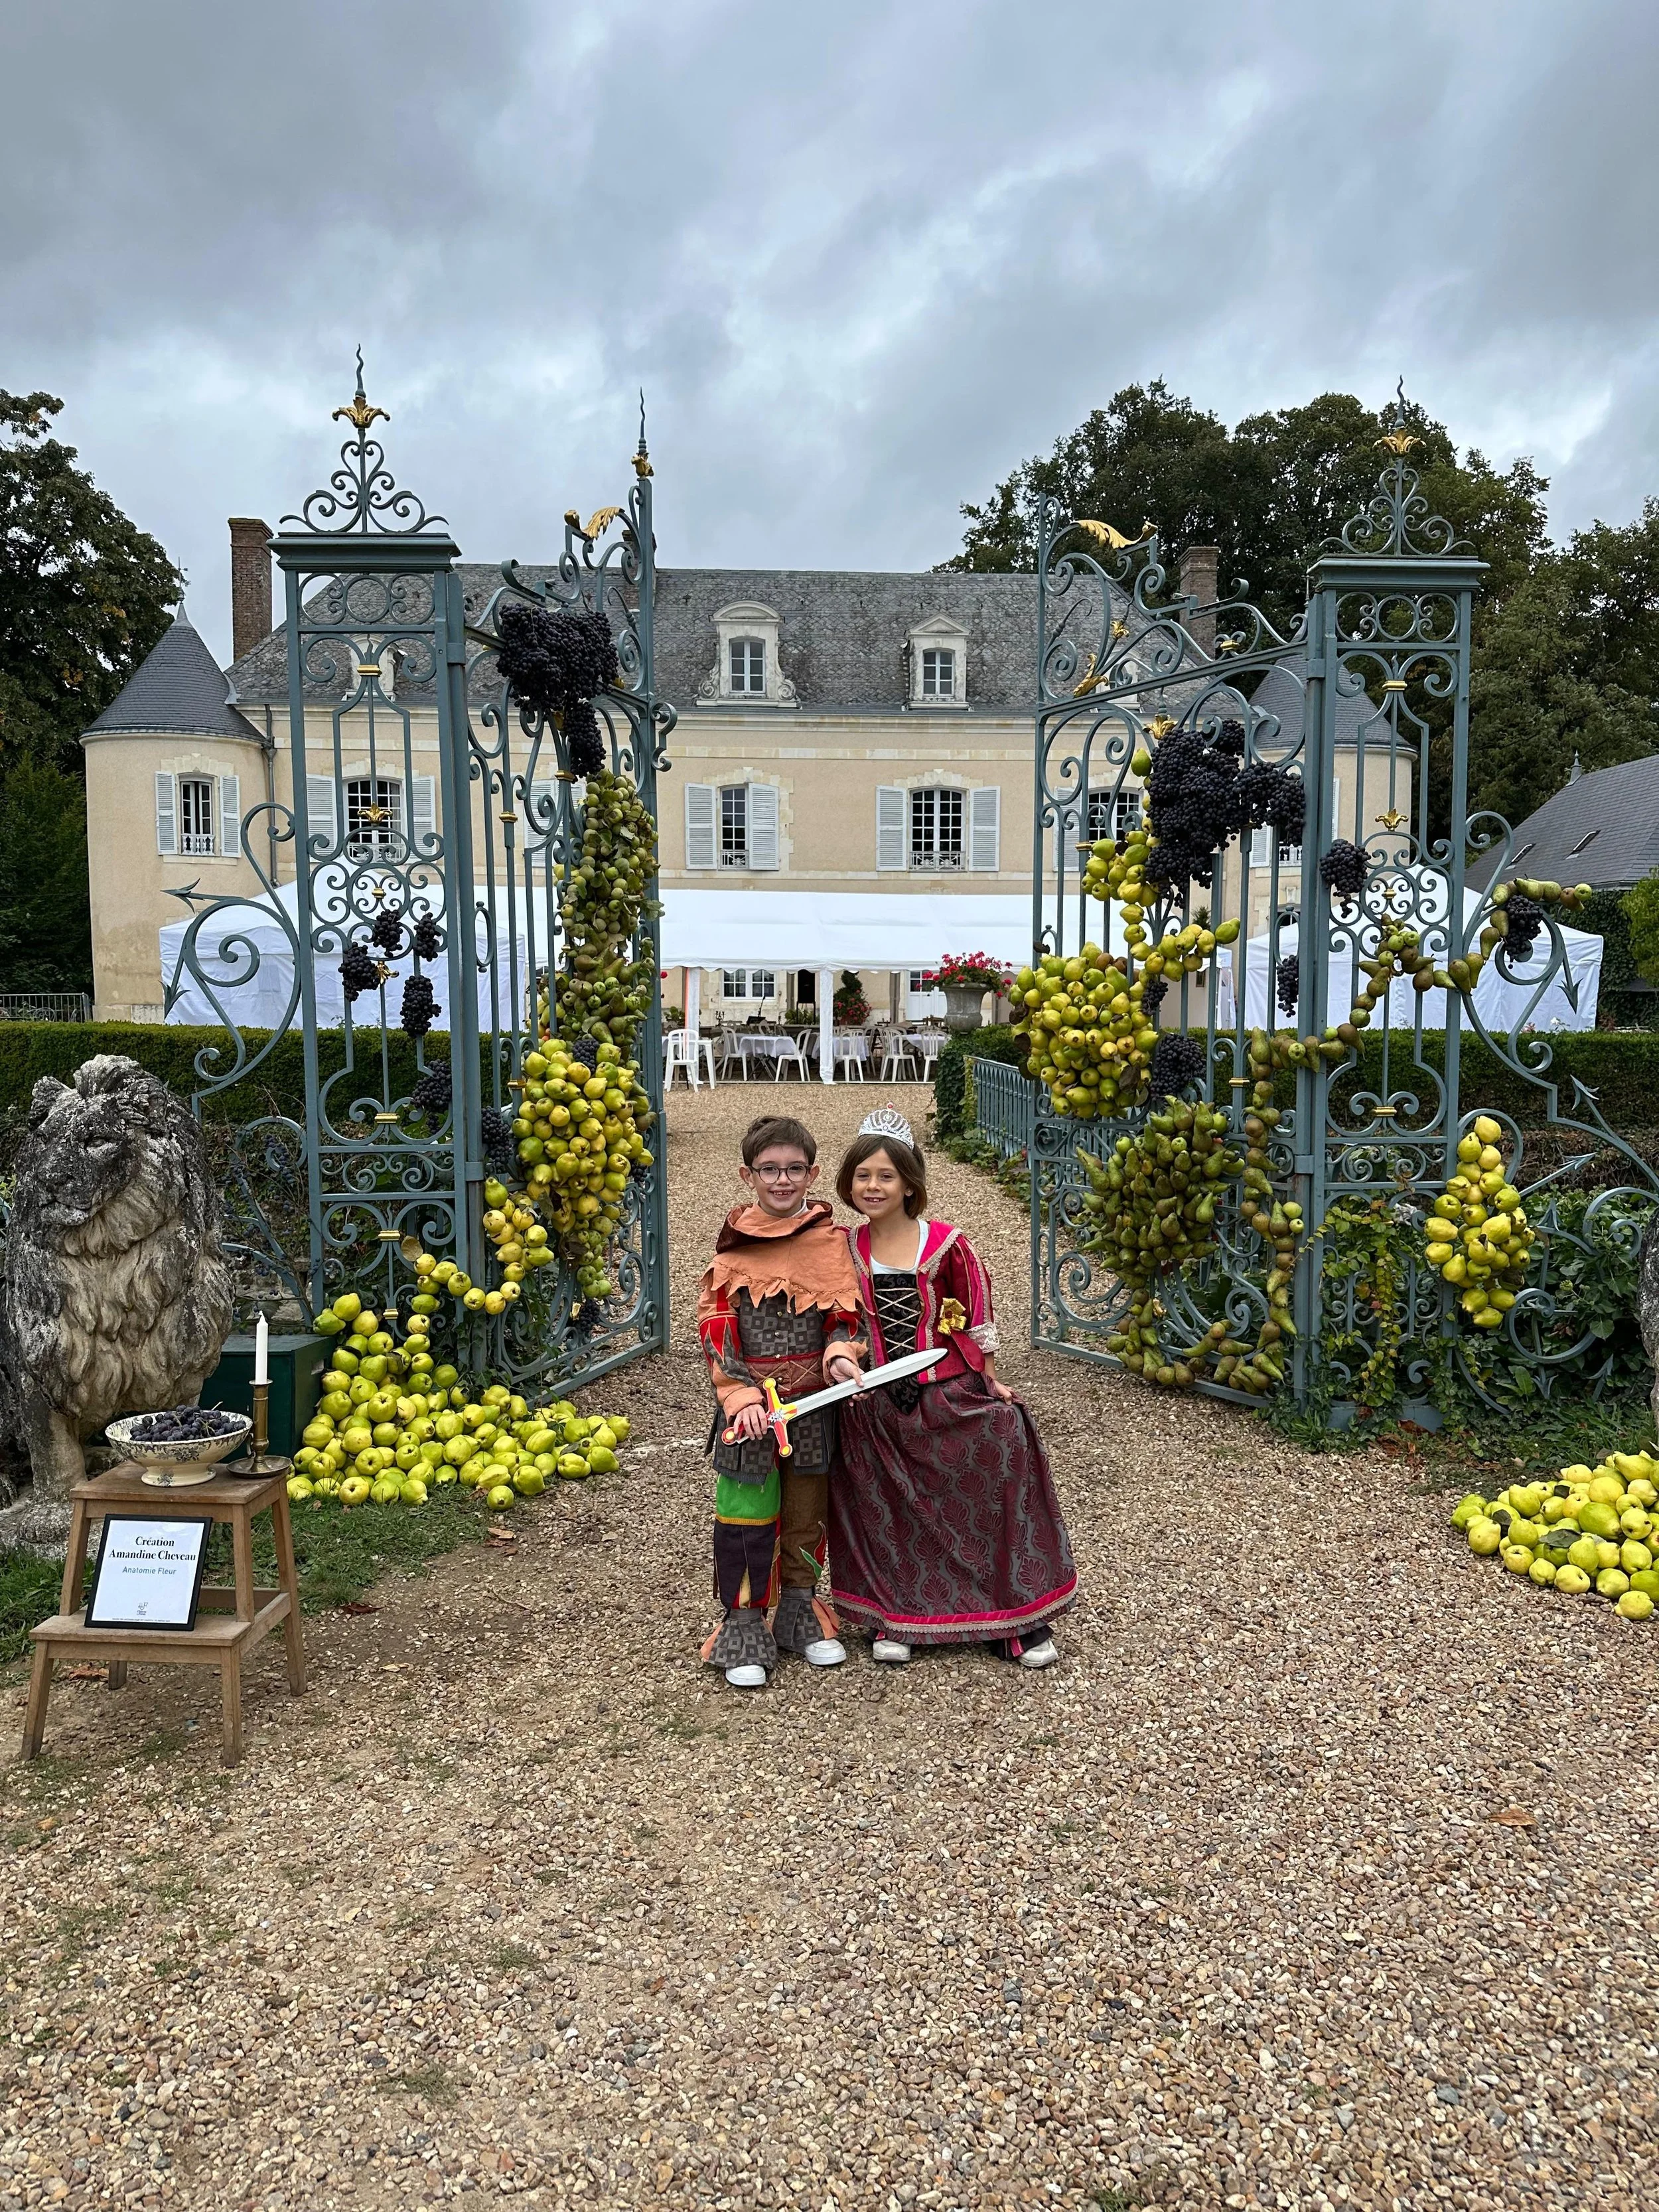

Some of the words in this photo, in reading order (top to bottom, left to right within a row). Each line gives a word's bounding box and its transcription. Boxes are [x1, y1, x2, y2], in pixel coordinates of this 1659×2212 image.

[135, 1536, 175, 1546] Création
[109, 1549, 157, 1560] Amandine
[158, 1550, 196, 1561] Cheveau
